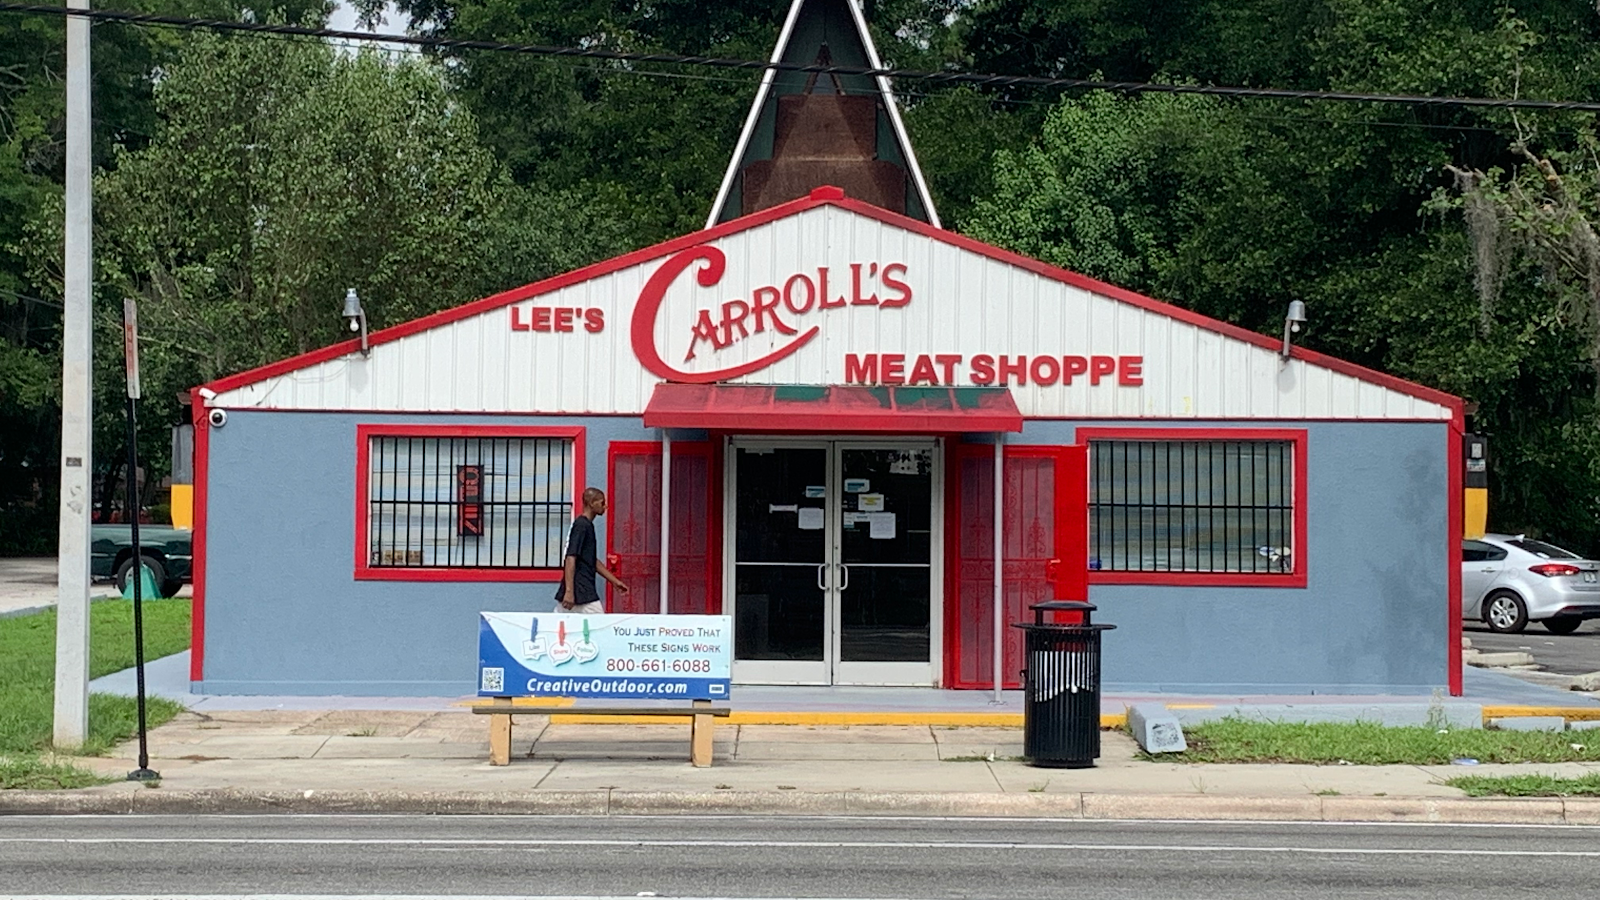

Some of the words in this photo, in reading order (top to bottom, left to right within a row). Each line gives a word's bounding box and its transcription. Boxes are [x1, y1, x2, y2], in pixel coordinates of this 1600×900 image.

[511, 306, 605, 333] LEE'S
[630, 244, 912, 384] CARROLL'S
[844, 353, 962, 385] MEAT
[969, 353, 1144, 386] SHOPPE
[606, 658, 711, 673] 800-661-6088
[526, 678, 688, 695] CreativeOutdoor.com
